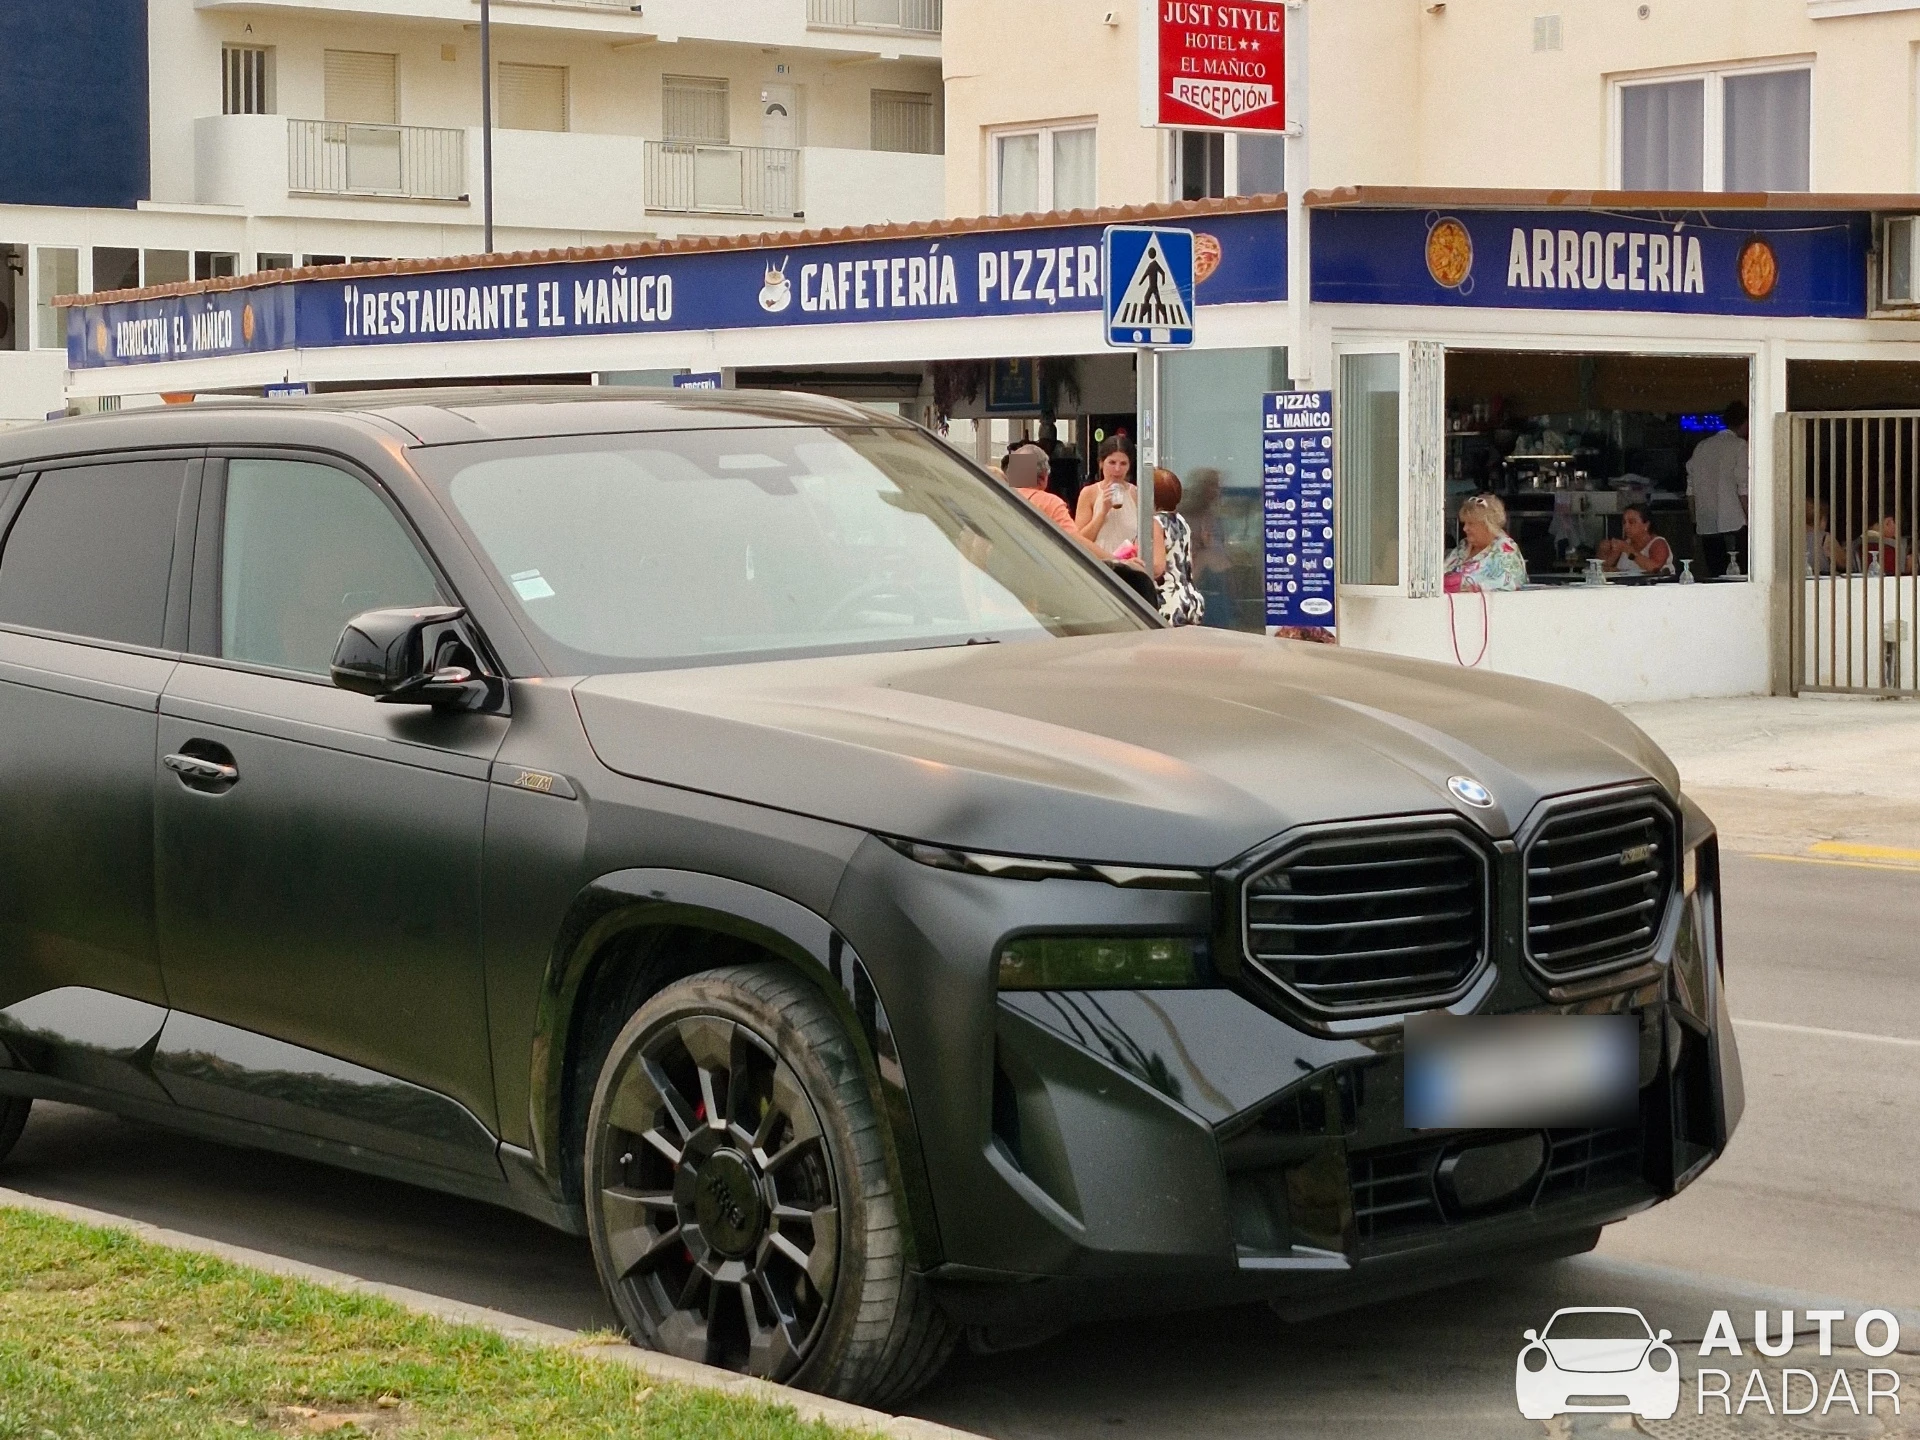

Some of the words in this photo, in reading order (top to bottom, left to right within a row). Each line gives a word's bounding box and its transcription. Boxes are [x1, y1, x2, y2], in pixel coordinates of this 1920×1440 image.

[1164, 1, 1213, 26] JUST
[1217, 6, 1280, 33] STYLE
[1185, 32, 1237, 51] HOTEL
[1181, 57, 1199, 73] EL
[1204, 57, 1266, 79] MAÑICO
[1179, 84, 1267, 116] RECEPCIÓN
[1507, 221, 1704, 294] ARROCERÍA
[800, 243, 958, 312] CAFETERÍA
[362, 282, 528, 337] RESTAURANTE
[538, 281, 565, 327] EL
[574, 265, 673, 325] MAÑICO
[116, 309, 169, 358] ARROCERÍA
[174, 316, 188, 353] EL
[192, 302, 232, 351] MAÑICO
[1275, 393, 1320, 410] PIZZAS
[1266, 414, 1281, 429] EL
[1283, 410, 1331, 429] MAÑICO
